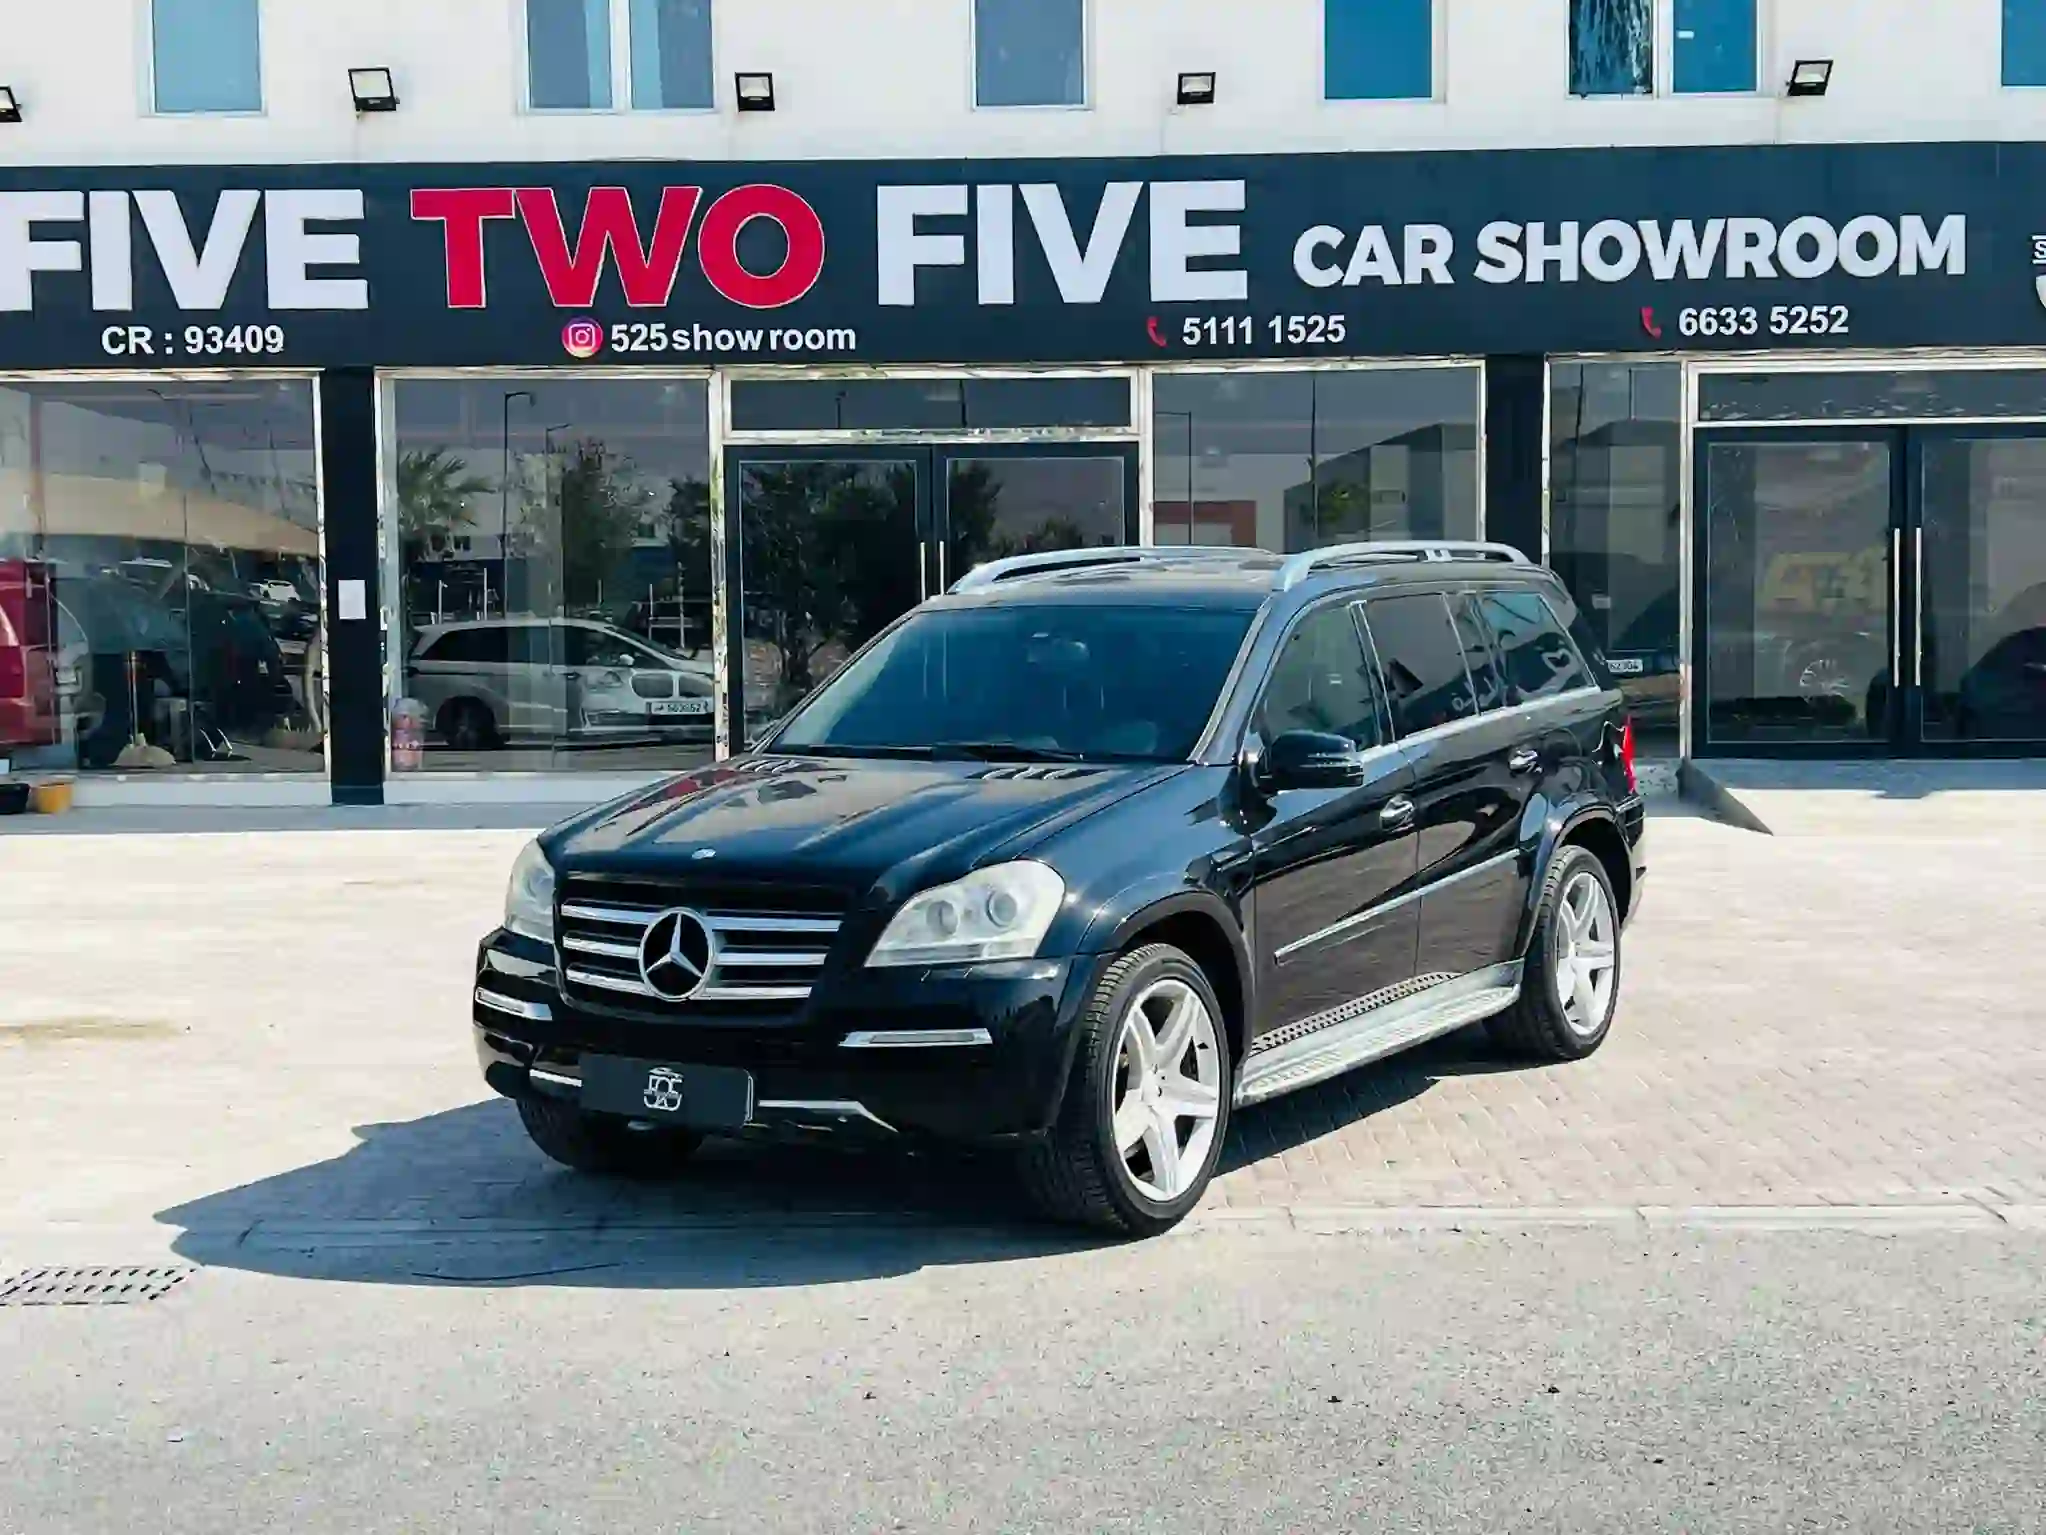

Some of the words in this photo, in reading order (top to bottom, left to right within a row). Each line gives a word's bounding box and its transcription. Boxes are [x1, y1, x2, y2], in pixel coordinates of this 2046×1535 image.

[0, 189, 369, 312] FIVE
[409, 184, 827, 309] TWO
[877, 180, 1248, 306] FIVE
[1293, 223, 1455, 288] CAR
[1473, 215, 1966, 281] SHOWROOM
[1182, 316, 1252, 346] 5111
[1268, 314, 1346, 344] 1525
[1679, 307, 1758, 336] 6633
[1769, 306, 1850, 335] 5252
[101, 325, 155, 355] CR
[184, 325, 285, 355] 93409
